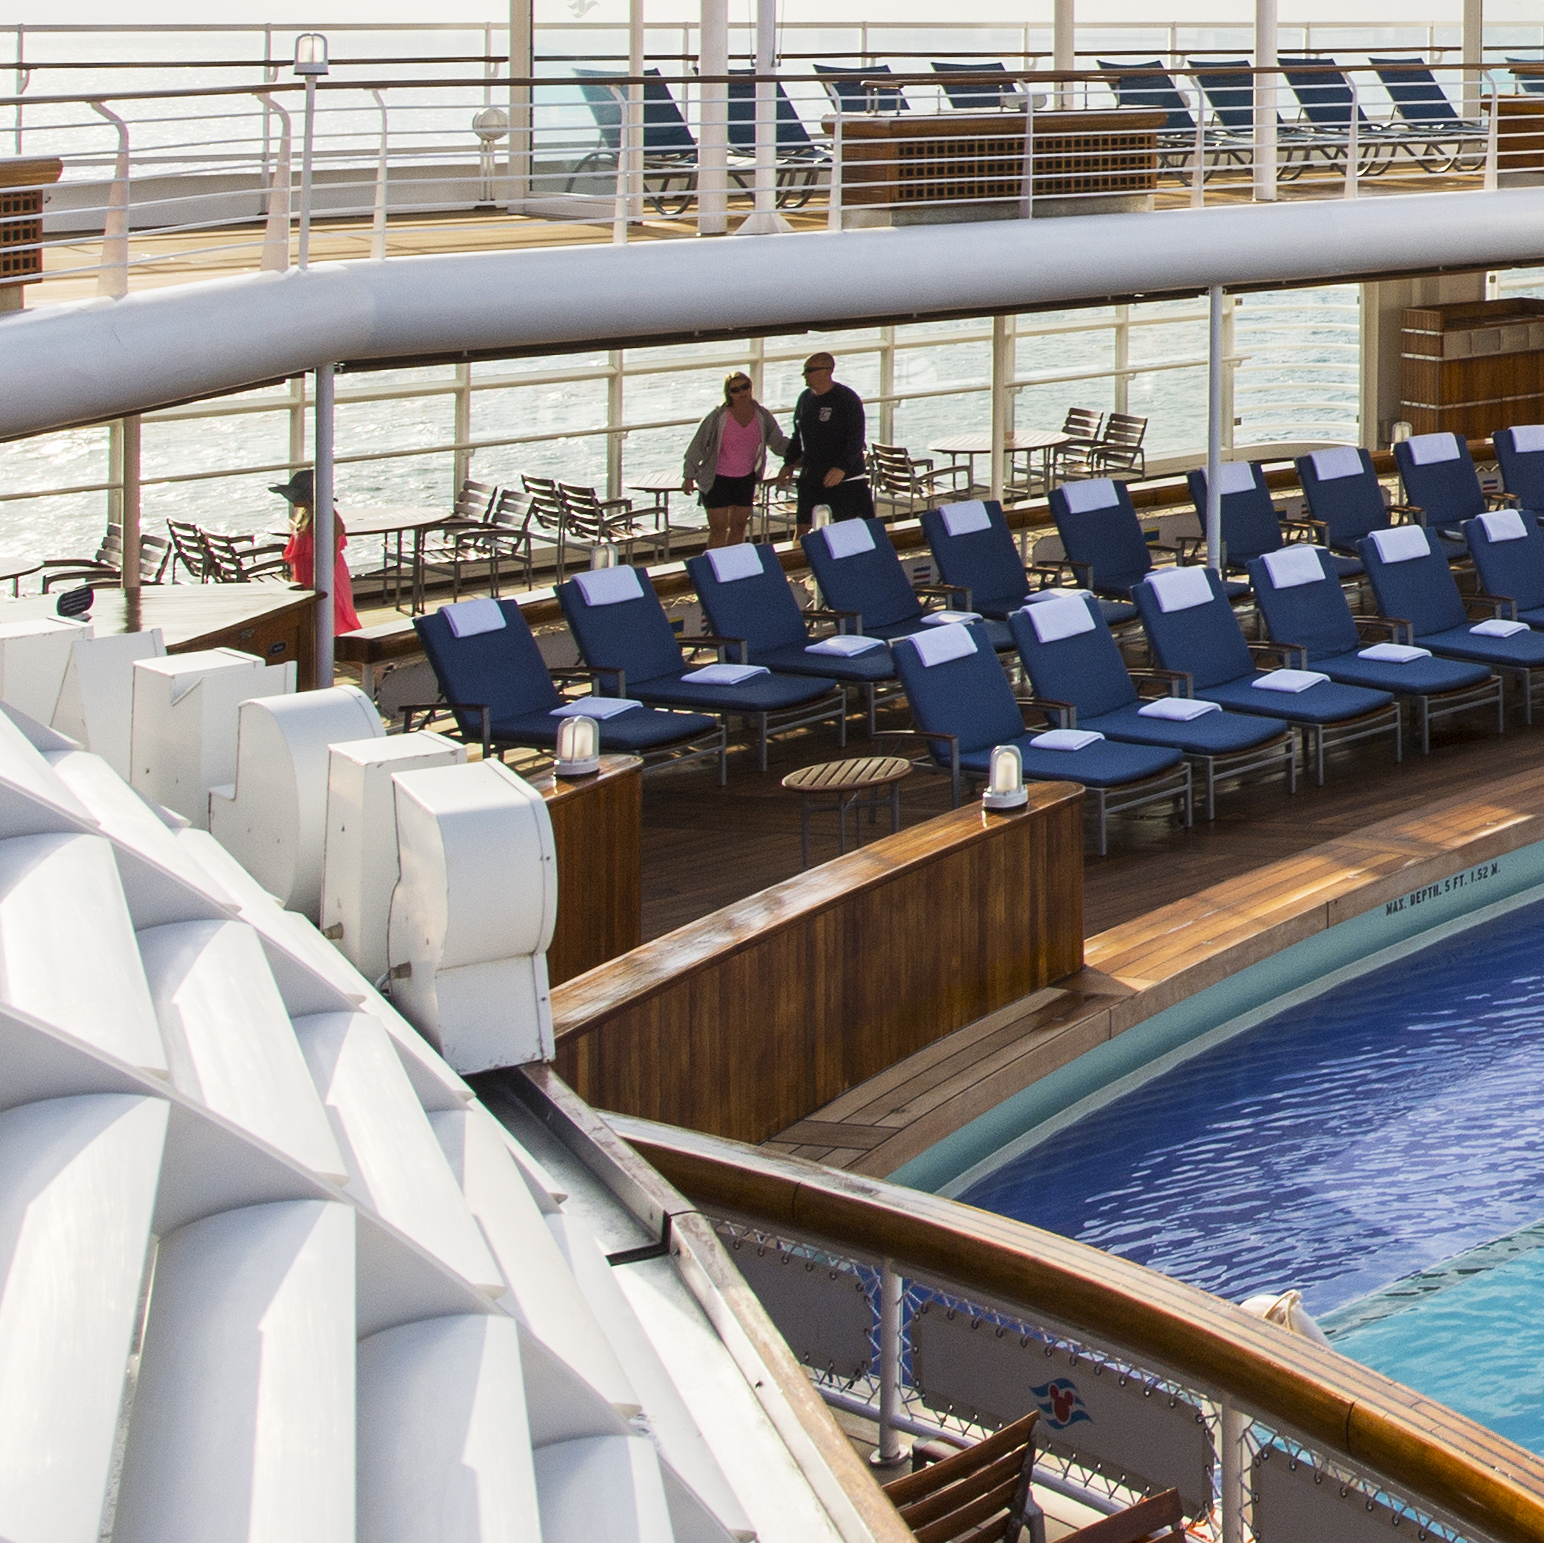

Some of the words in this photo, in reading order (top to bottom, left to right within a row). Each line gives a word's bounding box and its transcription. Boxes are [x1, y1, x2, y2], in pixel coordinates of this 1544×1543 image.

[1386, 898, 1407, 916] MAX.
[1410, 884, 1442, 906] DEPTH.
[1444, 880, 1450, 892] 5
[1453, 874, 1468, 890] FT.
[1470, 866, 1488, 883] 1.52
[1491, 862, 1500, 876] M.
